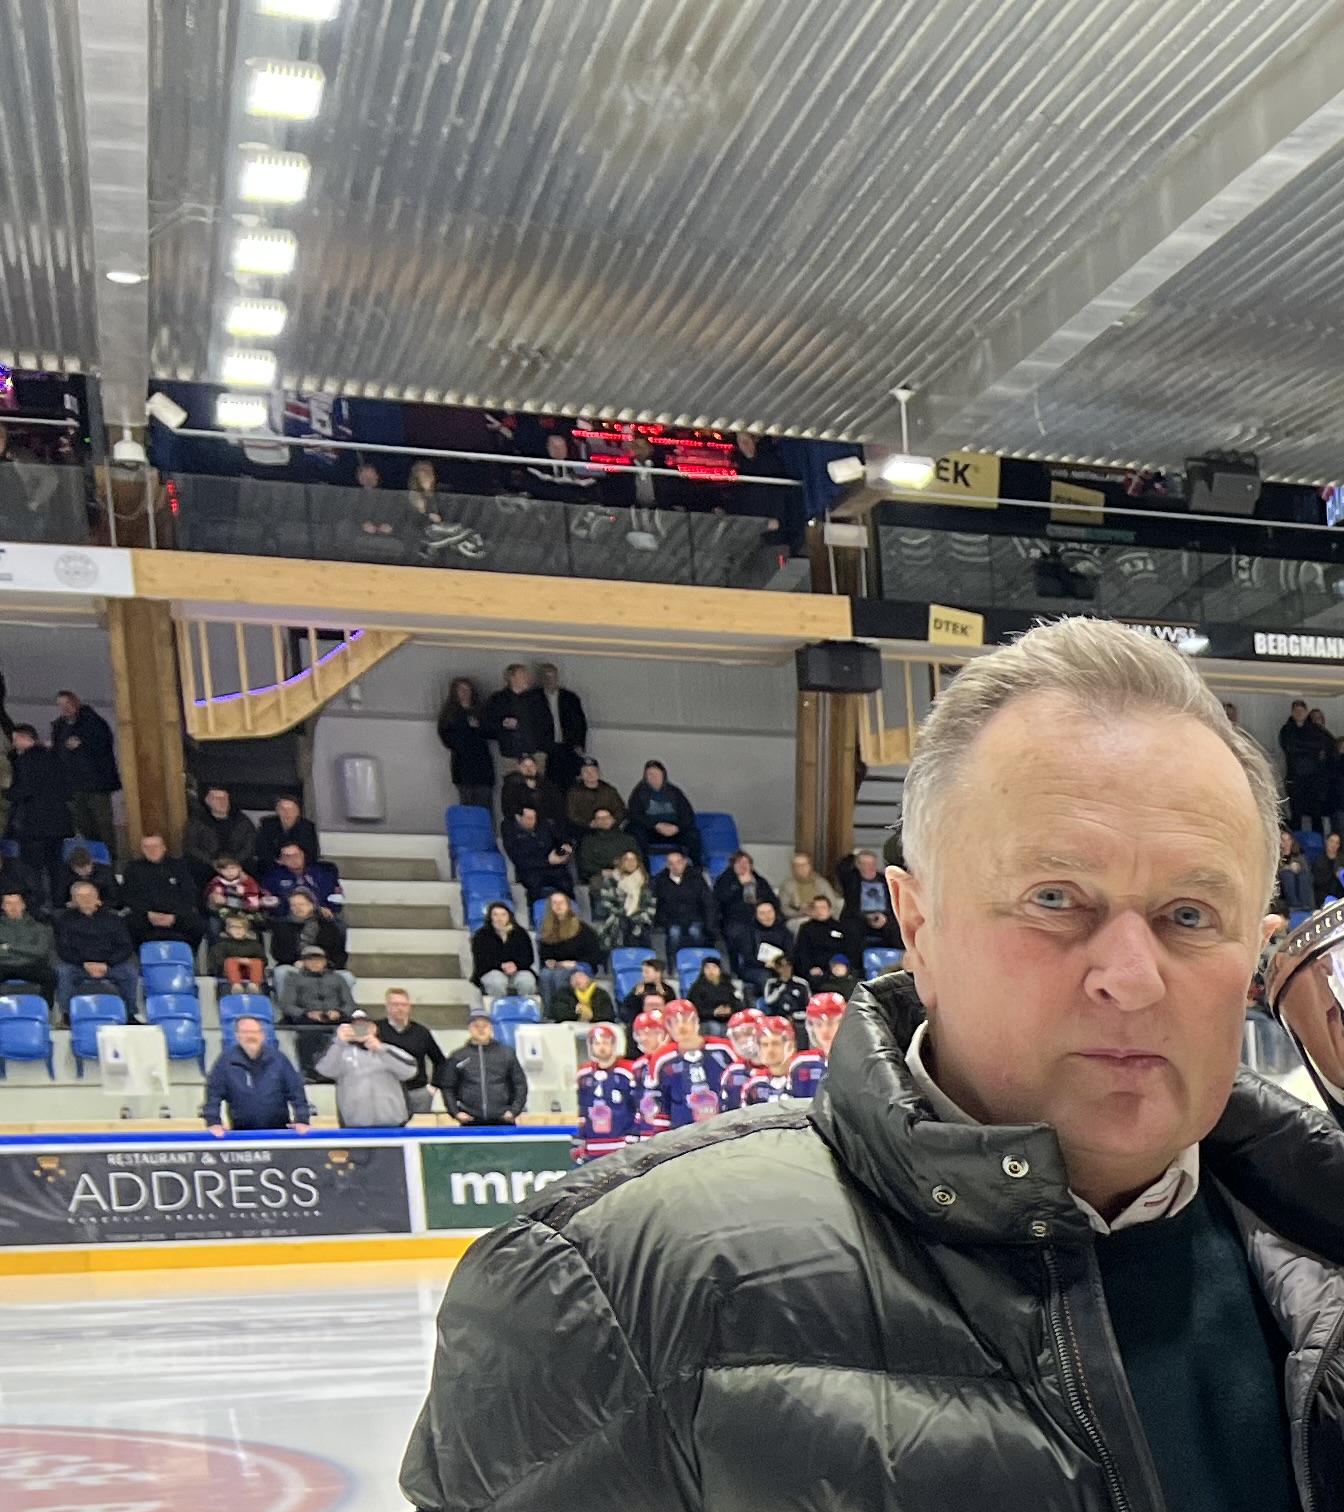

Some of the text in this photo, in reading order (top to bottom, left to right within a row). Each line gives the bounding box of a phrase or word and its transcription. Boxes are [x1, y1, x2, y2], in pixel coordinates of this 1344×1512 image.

[935, 457, 971, 488] EK
[106, 1150, 272, 1166] RESTAURANT & VINBAR
[67, 1167, 321, 1214] ADDRESS
